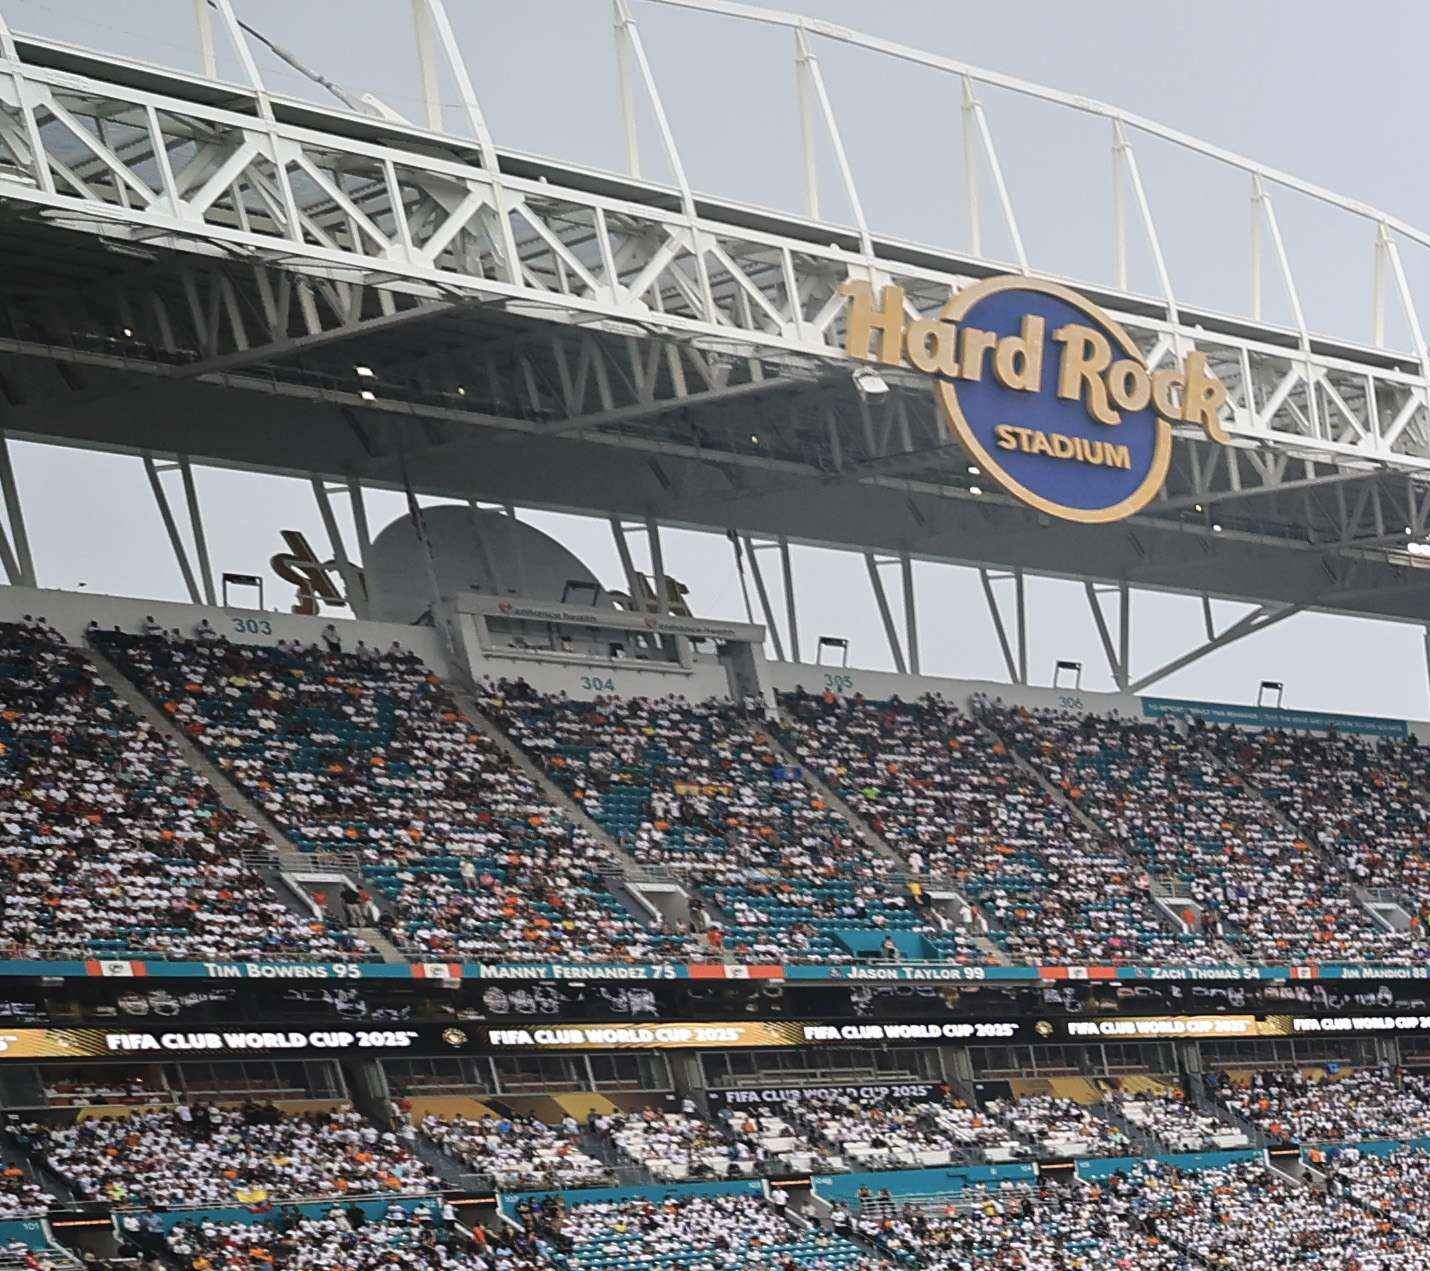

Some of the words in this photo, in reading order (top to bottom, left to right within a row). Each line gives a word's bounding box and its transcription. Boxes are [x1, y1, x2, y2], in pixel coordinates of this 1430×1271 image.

[838, 279, 1045, 392] Hard
[1052, 323, 1230, 445] Rock
[995, 424, 1131, 470] STADIUM
[332, 962, 362, 978] 95
[963, 966, 986, 980] 99
[489, 1029, 535, 1044] FIFA
[534, 1029, 584, 1044] CLUB
[803, 1027, 841, 1040] FIFA
[842, 1026, 883, 1039] CLUB
[883, 1024, 942, 1038] WORLD
[942, 1024, 974, 1037] CUP
[106, 1034, 160, 1049] FIFA
[162, 1033, 222, 1049] CLUB
[223, 1032, 307, 1048] WORLD
[309, 1032, 354, 1047] CUP
